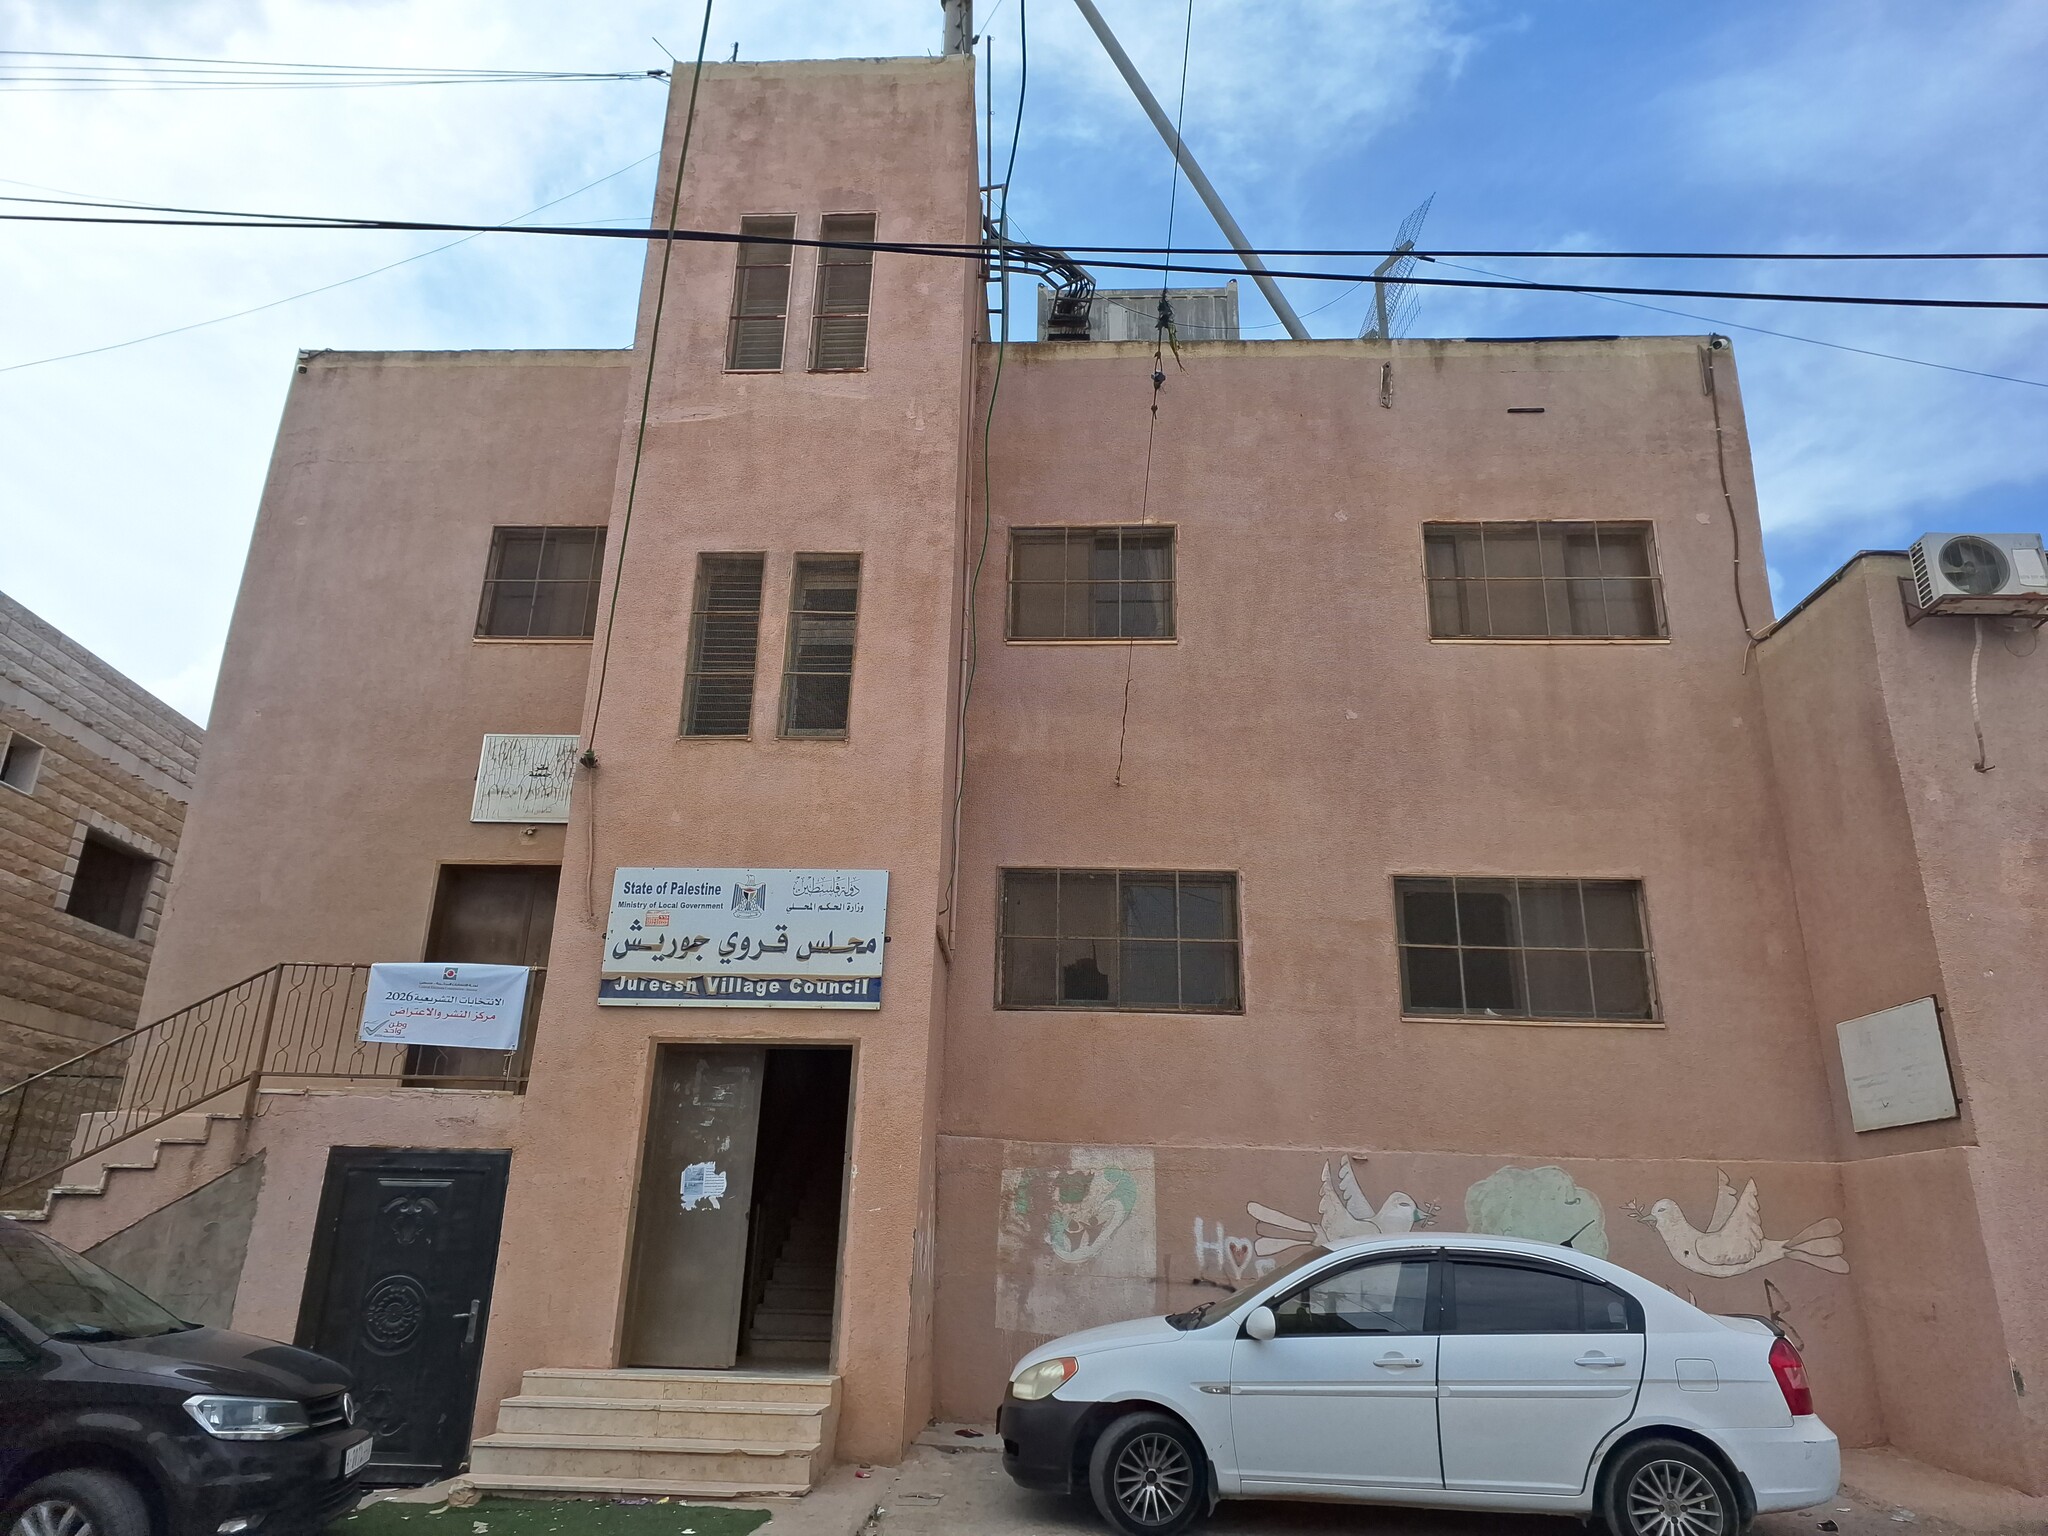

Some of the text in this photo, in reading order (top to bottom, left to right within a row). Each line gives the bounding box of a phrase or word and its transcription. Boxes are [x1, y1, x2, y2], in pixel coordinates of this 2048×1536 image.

[623, 881, 722, 896] State of Palestine
[792, 876, 841, 897] فلسطين
[617, 901, 724, 910] Ministry of Local Government
[785, 902, 864, 914] وزارة الحكم المحلي
[612, 918, 711, 962] جوريش
[718, 924, 789, 965] قروي
[795, 929, 877, 964] مجلس
[614, 976, 869, 997] Jureesh Village Council
[385, 991, 505, 1008] الانتخابات التشريعية 2026
[443, 1009, 471, 1020] النشر
[471, 1011, 496, 1022] مركز
[383, 1027, 402, 1036] واحد
[388, 1020, 408, 1029] وطن
